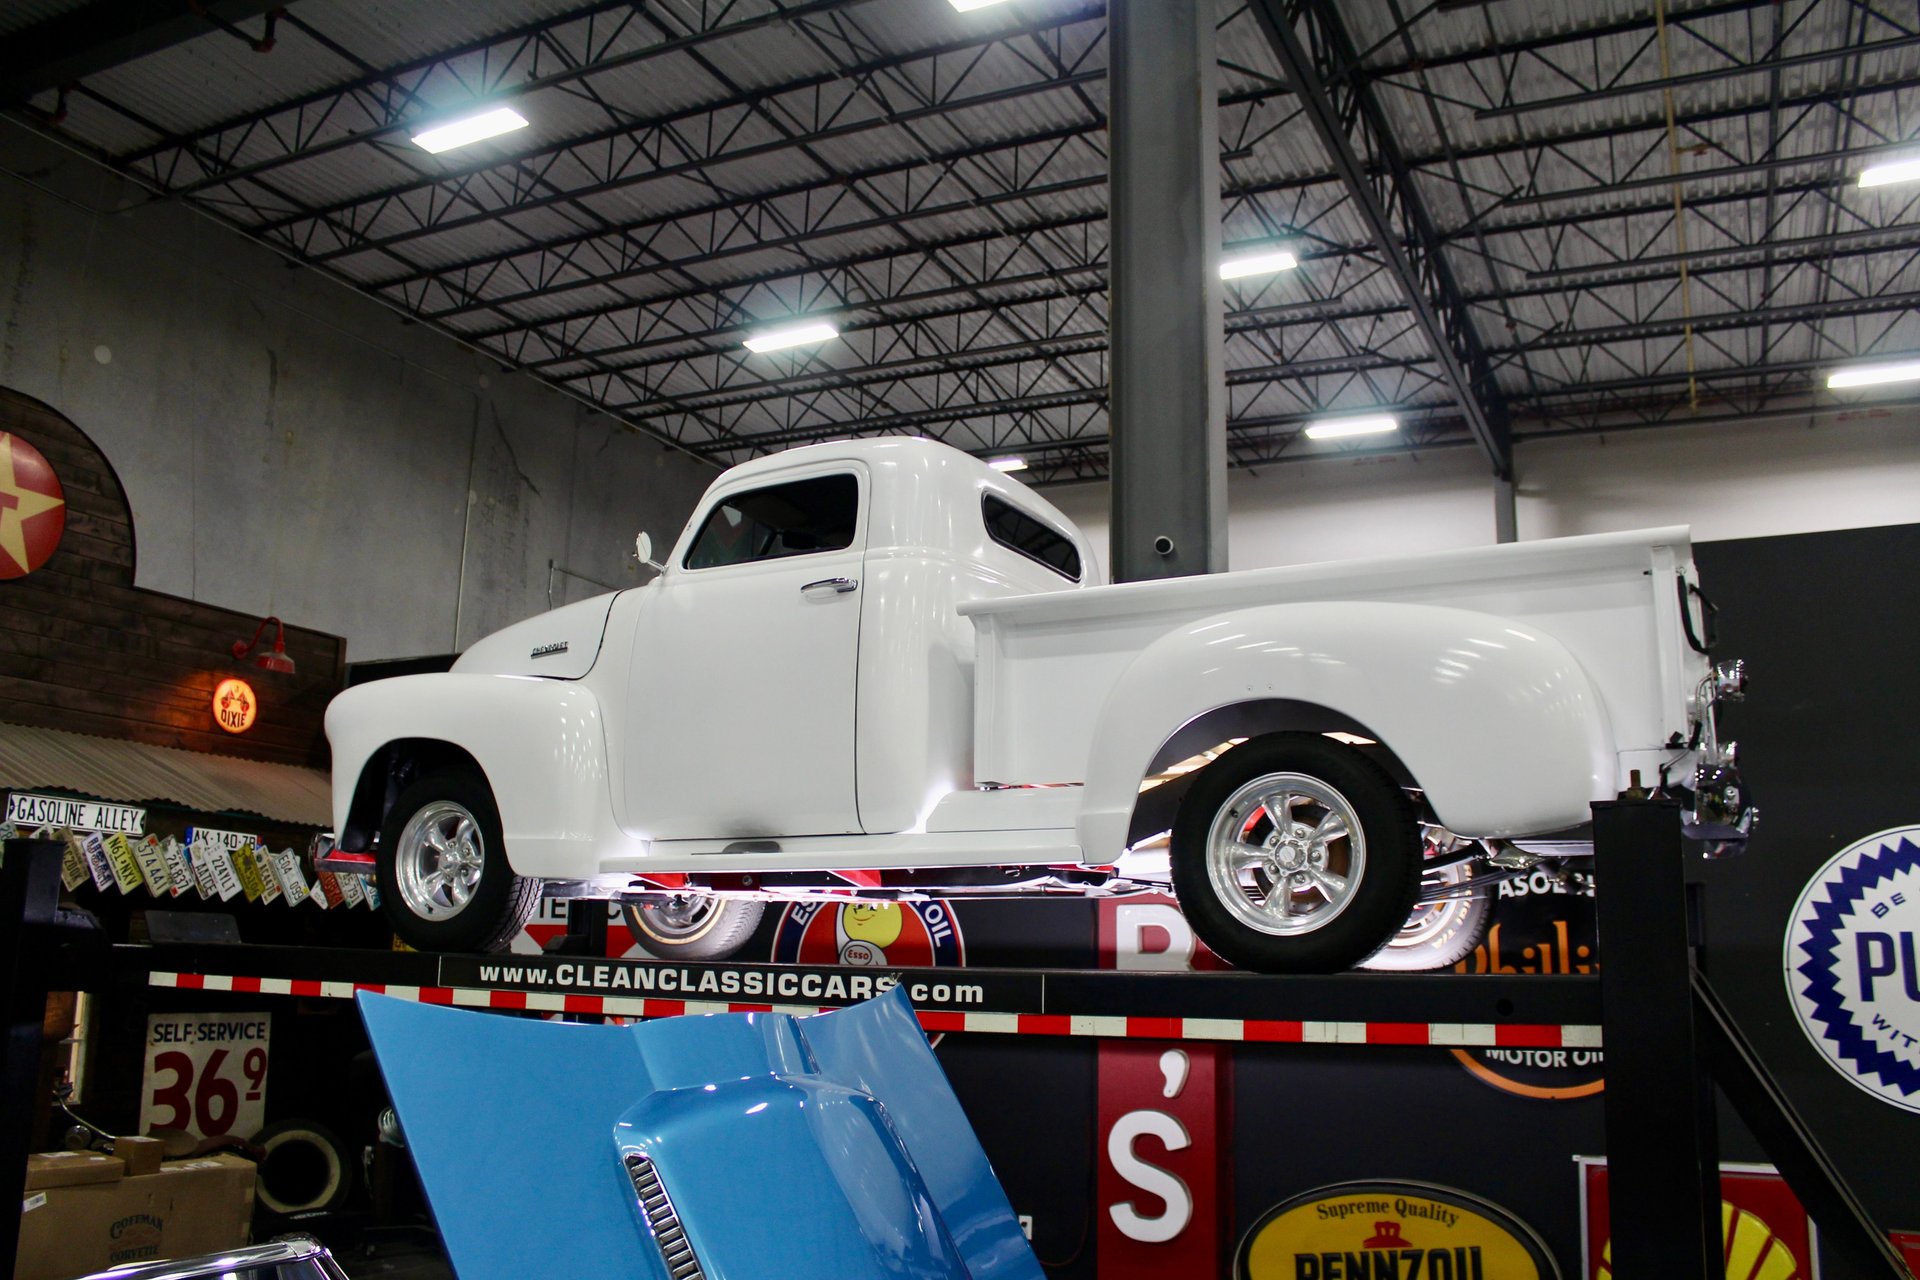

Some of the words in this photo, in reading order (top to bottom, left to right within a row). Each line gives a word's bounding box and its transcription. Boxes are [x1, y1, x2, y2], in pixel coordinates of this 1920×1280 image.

[220, 708, 246, 728] DIXIE
[17, 797, 87, 826] GASOLINE
[94, 805, 138, 832] ALLEY
[1870, 892, 1907, 919] BE
[924, 904, 952, 948] OIL
[1871, 1012, 1920, 1049] WIT
[1316, 1199, 1390, 1220] Supreme
[1394, 1198, 1460, 1228] Quality
